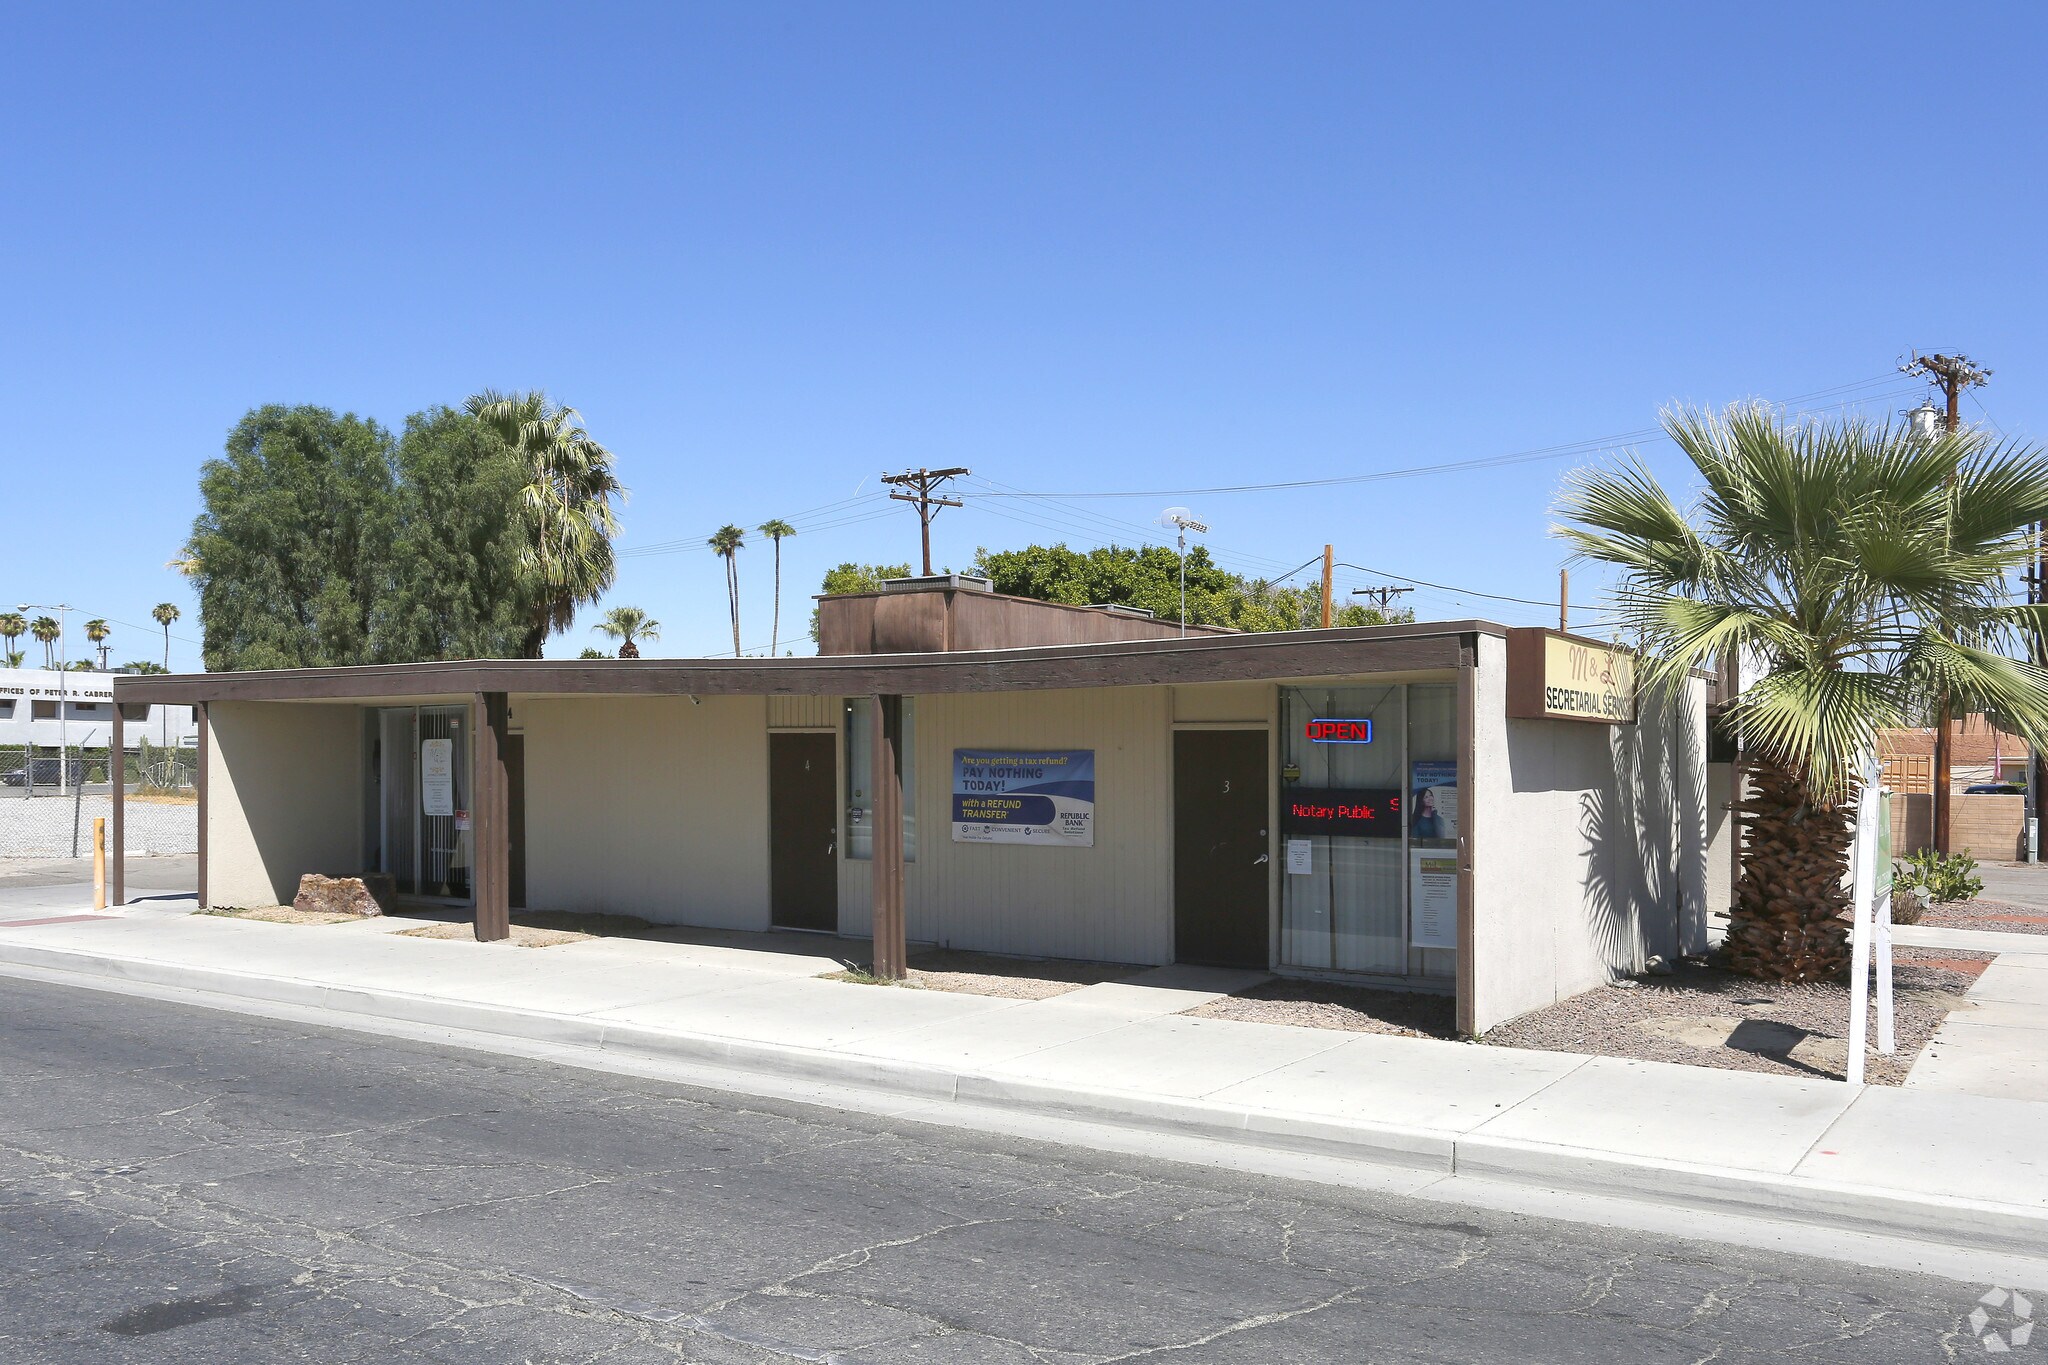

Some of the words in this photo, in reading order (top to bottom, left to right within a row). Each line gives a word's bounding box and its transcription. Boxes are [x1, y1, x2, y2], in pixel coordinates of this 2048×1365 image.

[1568, 645, 1588, 682] M
[1590, 656, 1599, 678] &
[1546, 686, 1602, 714] SECRETARIAL
[1305, 723, 1367, 739] OPEN
[805, 760, 810, 771] 4
[961, 756, 974, 764] Are
[975, 758, 989, 767] you
[991, 756, 1018, 767] getting
[1025, 757, 1037, 765] tax
[1038, 757, 1068, 765] refund?
[962, 767, 984, 778] PAY
[988, 768, 1043, 779] NOTHING
[962, 780, 1005, 791] TODAY!
[1223, 780, 1230, 793] 3
[962, 799, 979, 808] with
[987, 800, 1022, 809] REFUND
[1060, 812, 1090, 820] REPUBLIC
[1292, 804, 1335, 820] Notary
[1338, 805, 1375, 819] Public
